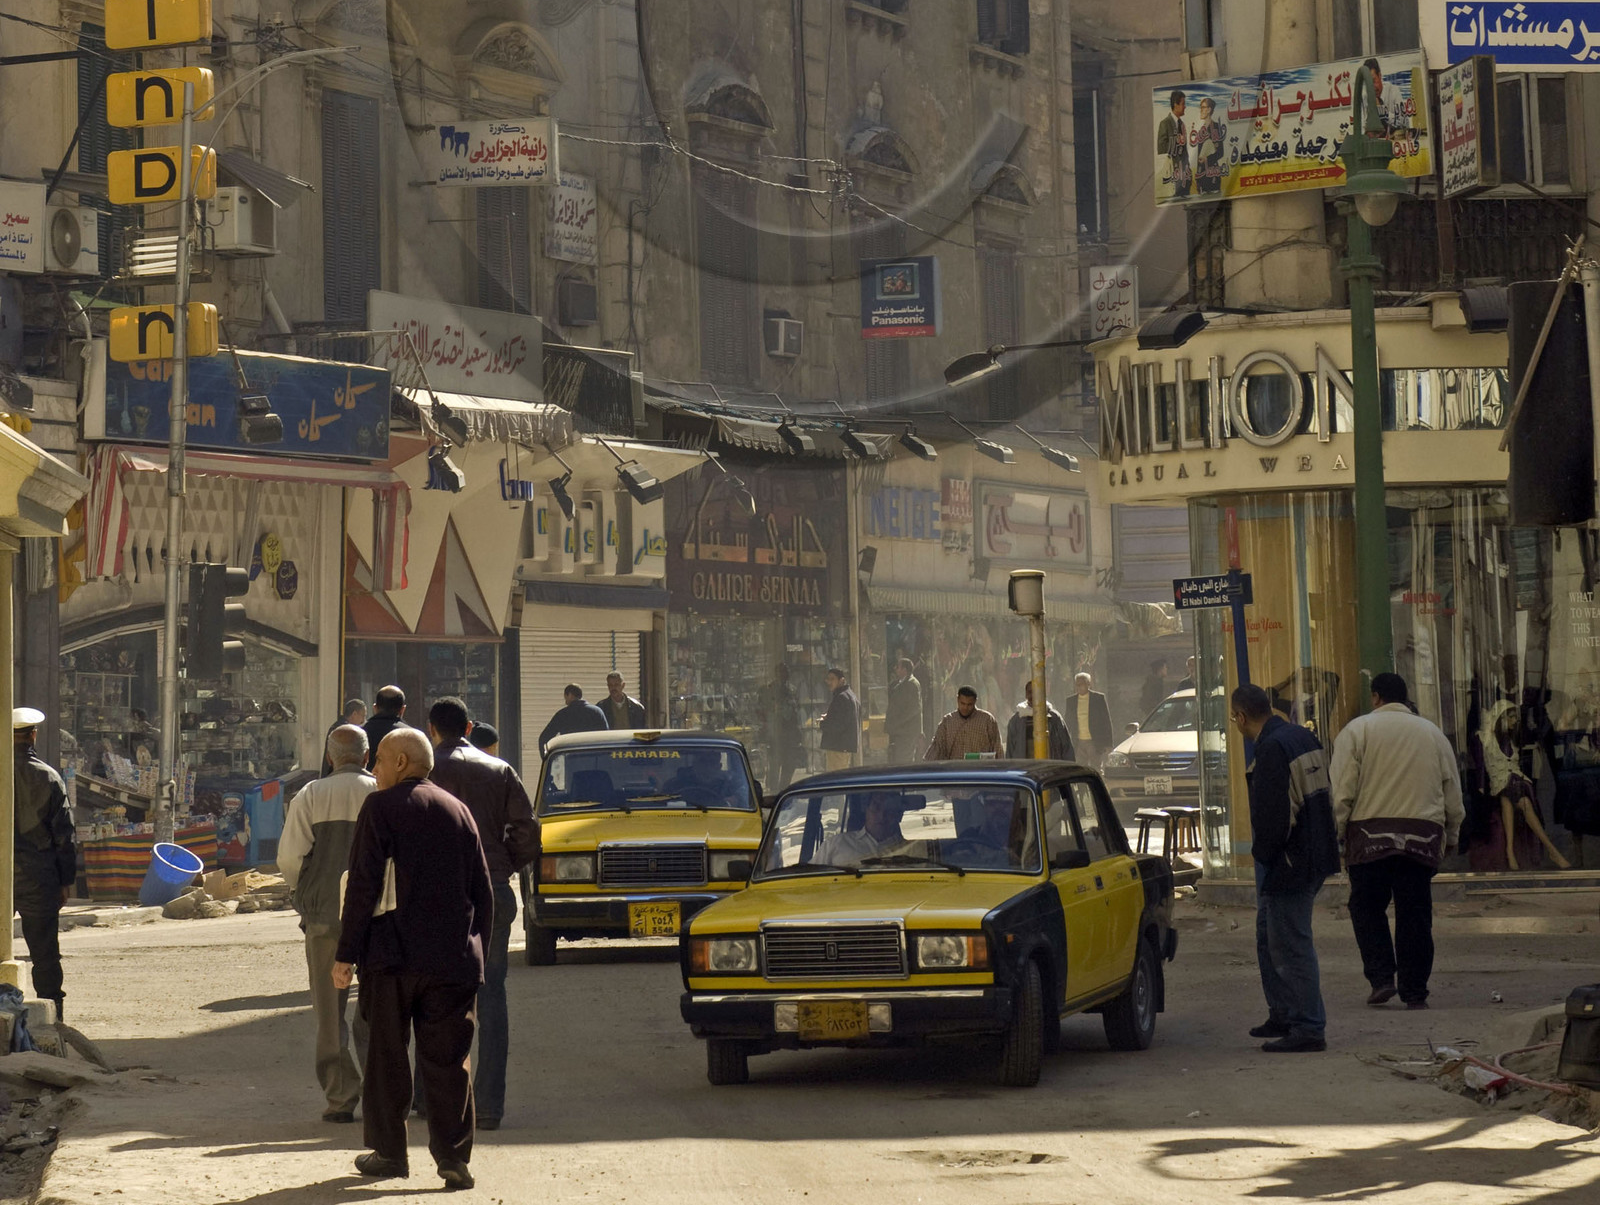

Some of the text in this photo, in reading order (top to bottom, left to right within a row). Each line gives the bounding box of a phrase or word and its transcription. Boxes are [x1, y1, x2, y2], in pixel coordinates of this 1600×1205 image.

[1227, 71, 1352, 128] تكنوجرافيك
[489, 124, 526, 135] دكتورة
[521, 135, 547, 161] رانية
[1230, 132, 1289, 165] معتمدة
[2, 212, 29, 226] سمير
[872, 314, 925, 325] Panasonic
[1098, 341, 1381, 466] MILLION
[168, 397, 216, 427] an
[1108, 453, 1350, 488] CASUAL WEA
[693, 572, 822, 606] GALIRE SEINAA
[1182, 598, 1189, 606] El
[1189, 597, 1202, 606] Nabi
[1203, 595, 1221, 604] Danial
[1569, 592, 1593, 602] WHAT
[1570, 608, 1582, 619] TO
[1261, 618, 1283, 633] Year
[1571, 623, 1590, 634] THIS
